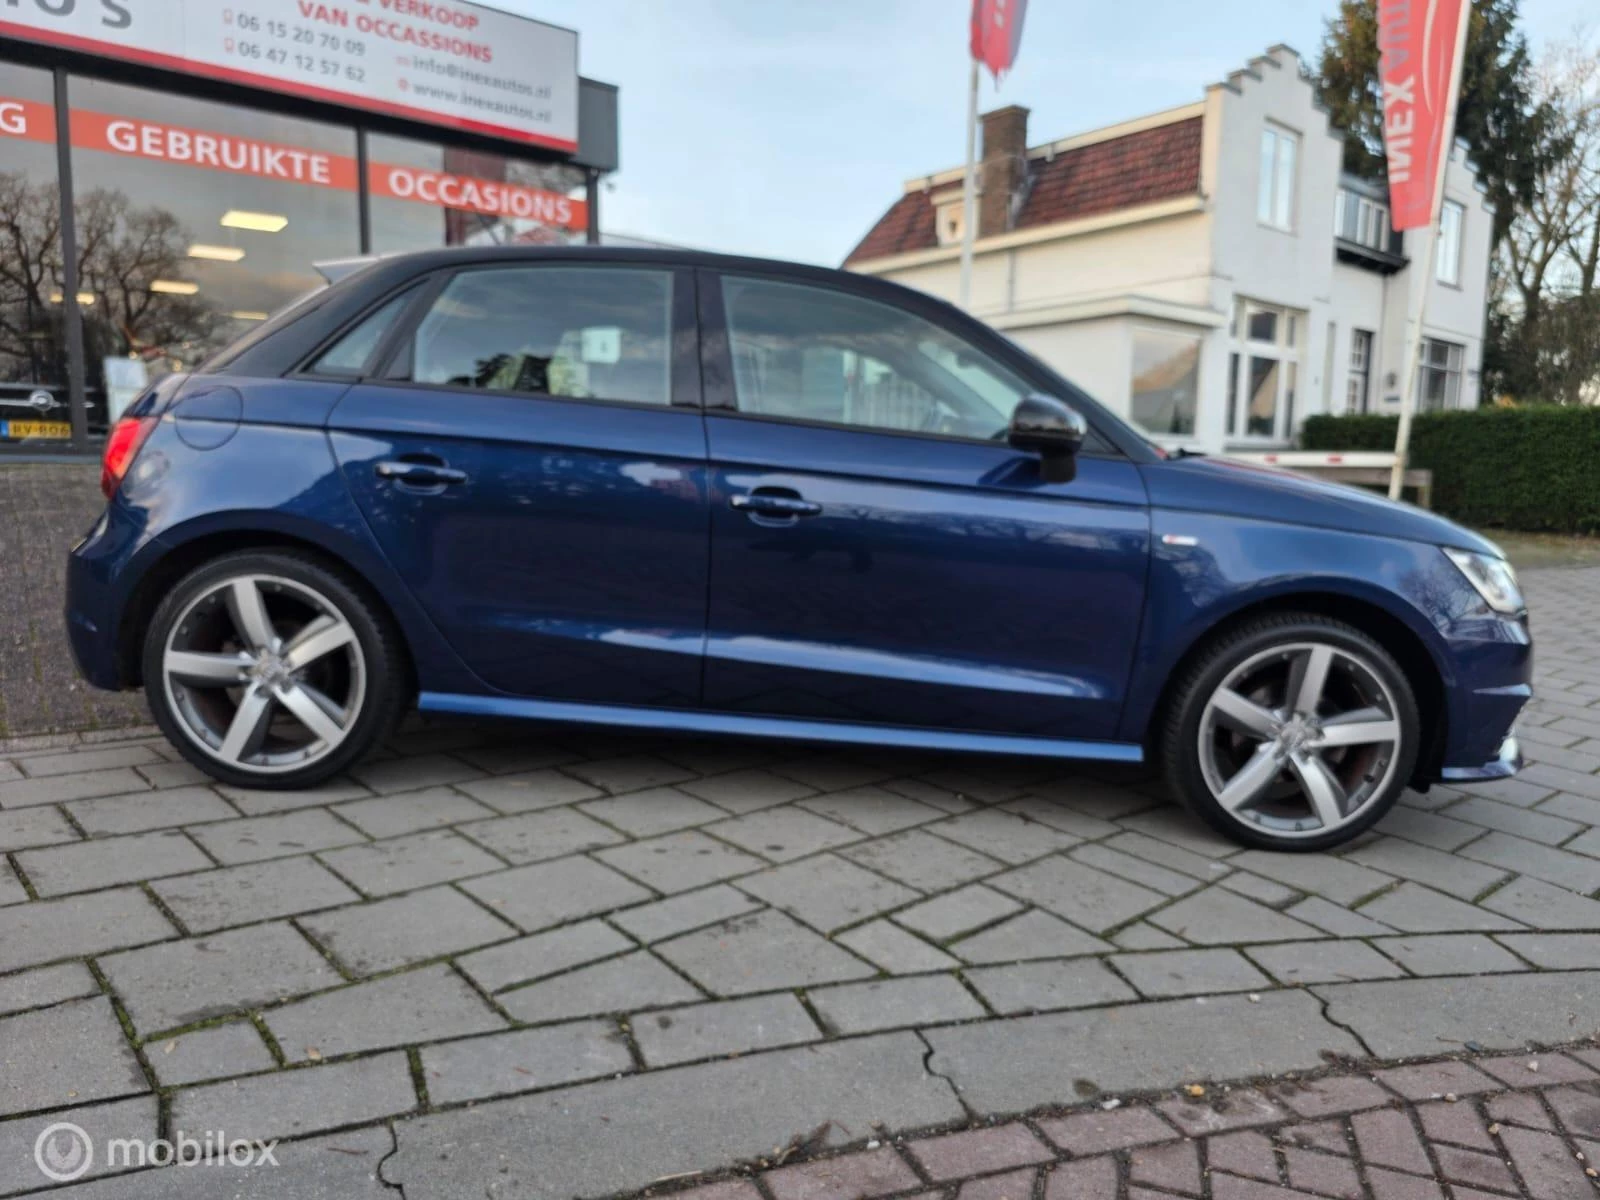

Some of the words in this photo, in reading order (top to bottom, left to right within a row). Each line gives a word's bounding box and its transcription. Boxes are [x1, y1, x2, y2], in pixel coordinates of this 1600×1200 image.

[237, 12, 260, 32] 06
[267, 20, 287, 38] 15
[293, 26, 314, 44] 20
[318, 32, 340, 51] 70
[297, 0, 348, 28] VAN
[355, 14, 493, 62] OCCASSIONS
[237, 41, 261, 59] 06
[266, 48, 288, 64] 47
[294, 54, 315, 72] 12
[319, 60, 340, 76] 57
[106, 120, 331, 184] GEBRUIKTE
[388, 169, 572, 224] OCCASIONS
